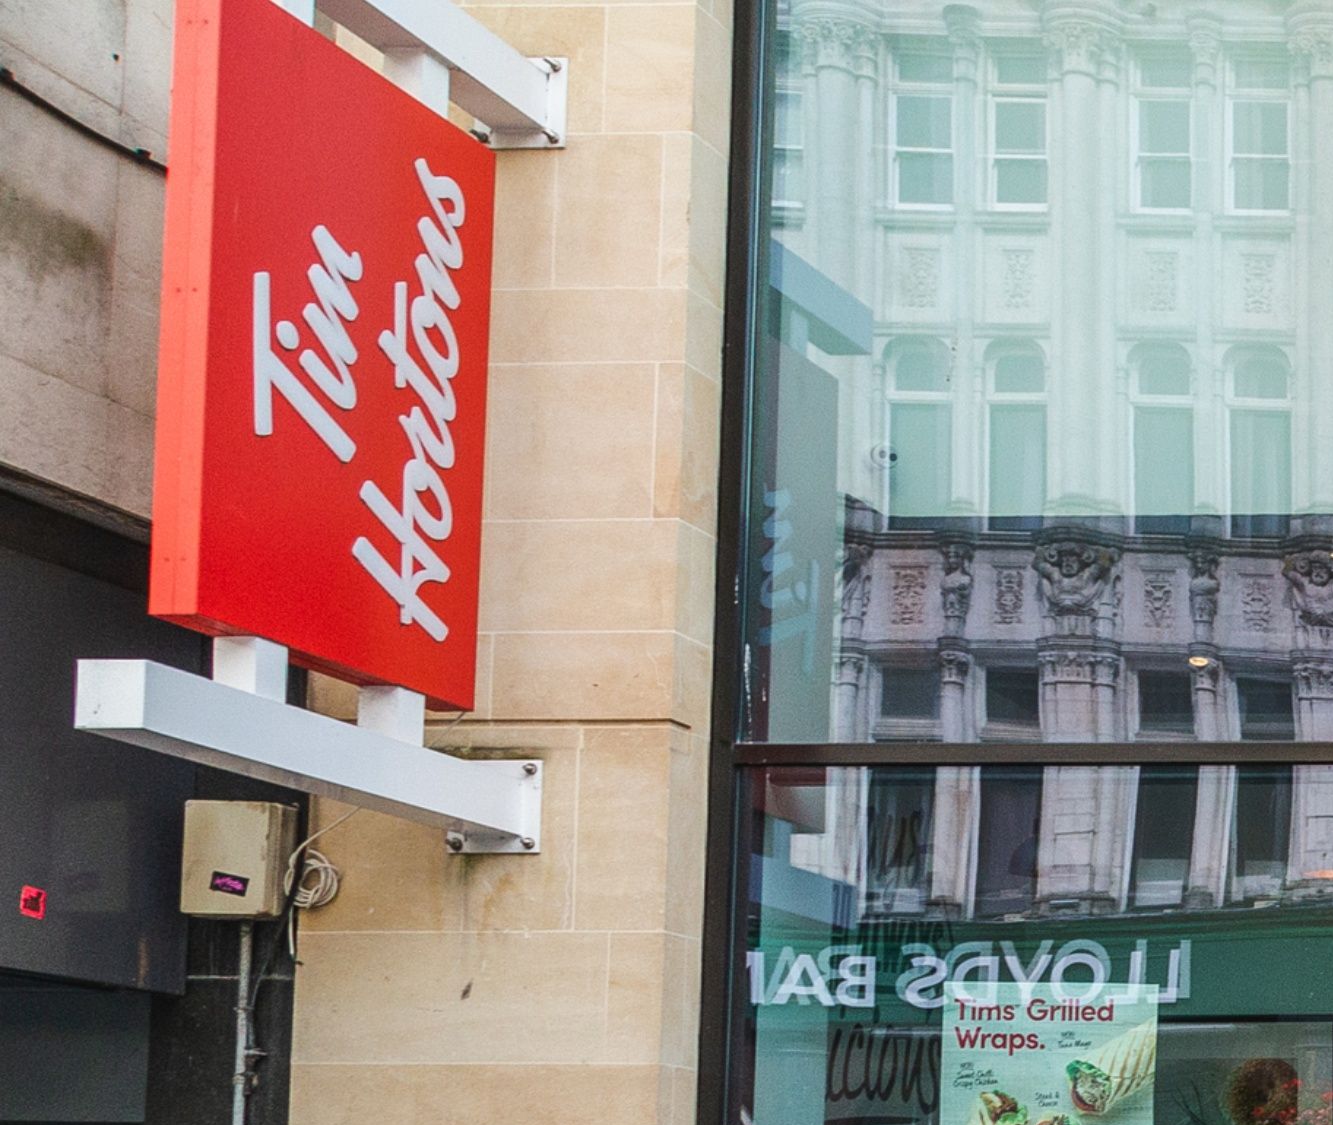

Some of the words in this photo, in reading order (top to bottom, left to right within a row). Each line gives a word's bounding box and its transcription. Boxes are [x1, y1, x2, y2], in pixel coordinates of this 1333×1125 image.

[252, 225, 362, 463] Tim
[351, 158, 467, 643] Hortons
[955, 1027, 1046, 1056] Wraps.
[1027, 998, 1114, 1022] Grilled
